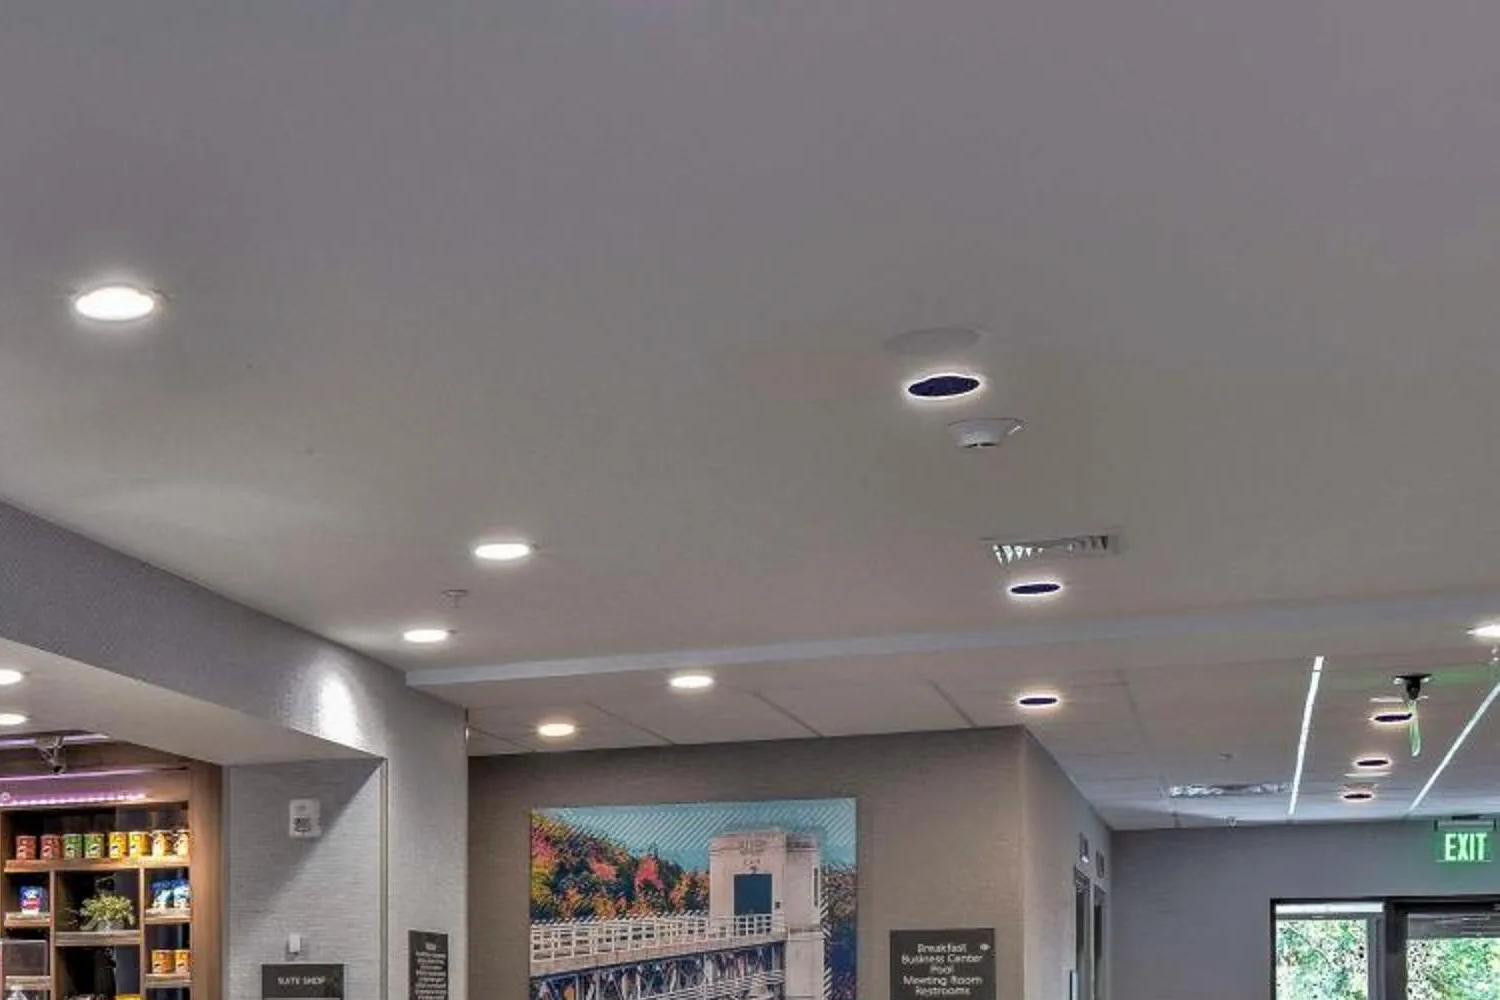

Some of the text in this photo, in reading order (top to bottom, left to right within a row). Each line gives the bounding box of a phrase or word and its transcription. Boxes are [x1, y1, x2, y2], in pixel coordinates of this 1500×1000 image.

[1445, 832, 1487, 861] EXIT
[917, 943, 967, 952] Breakfast
[901, 954, 983, 965] Business Center
[903, 976, 983, 986] Meeting Room
[915, 986, 971, 996] Restrooms
